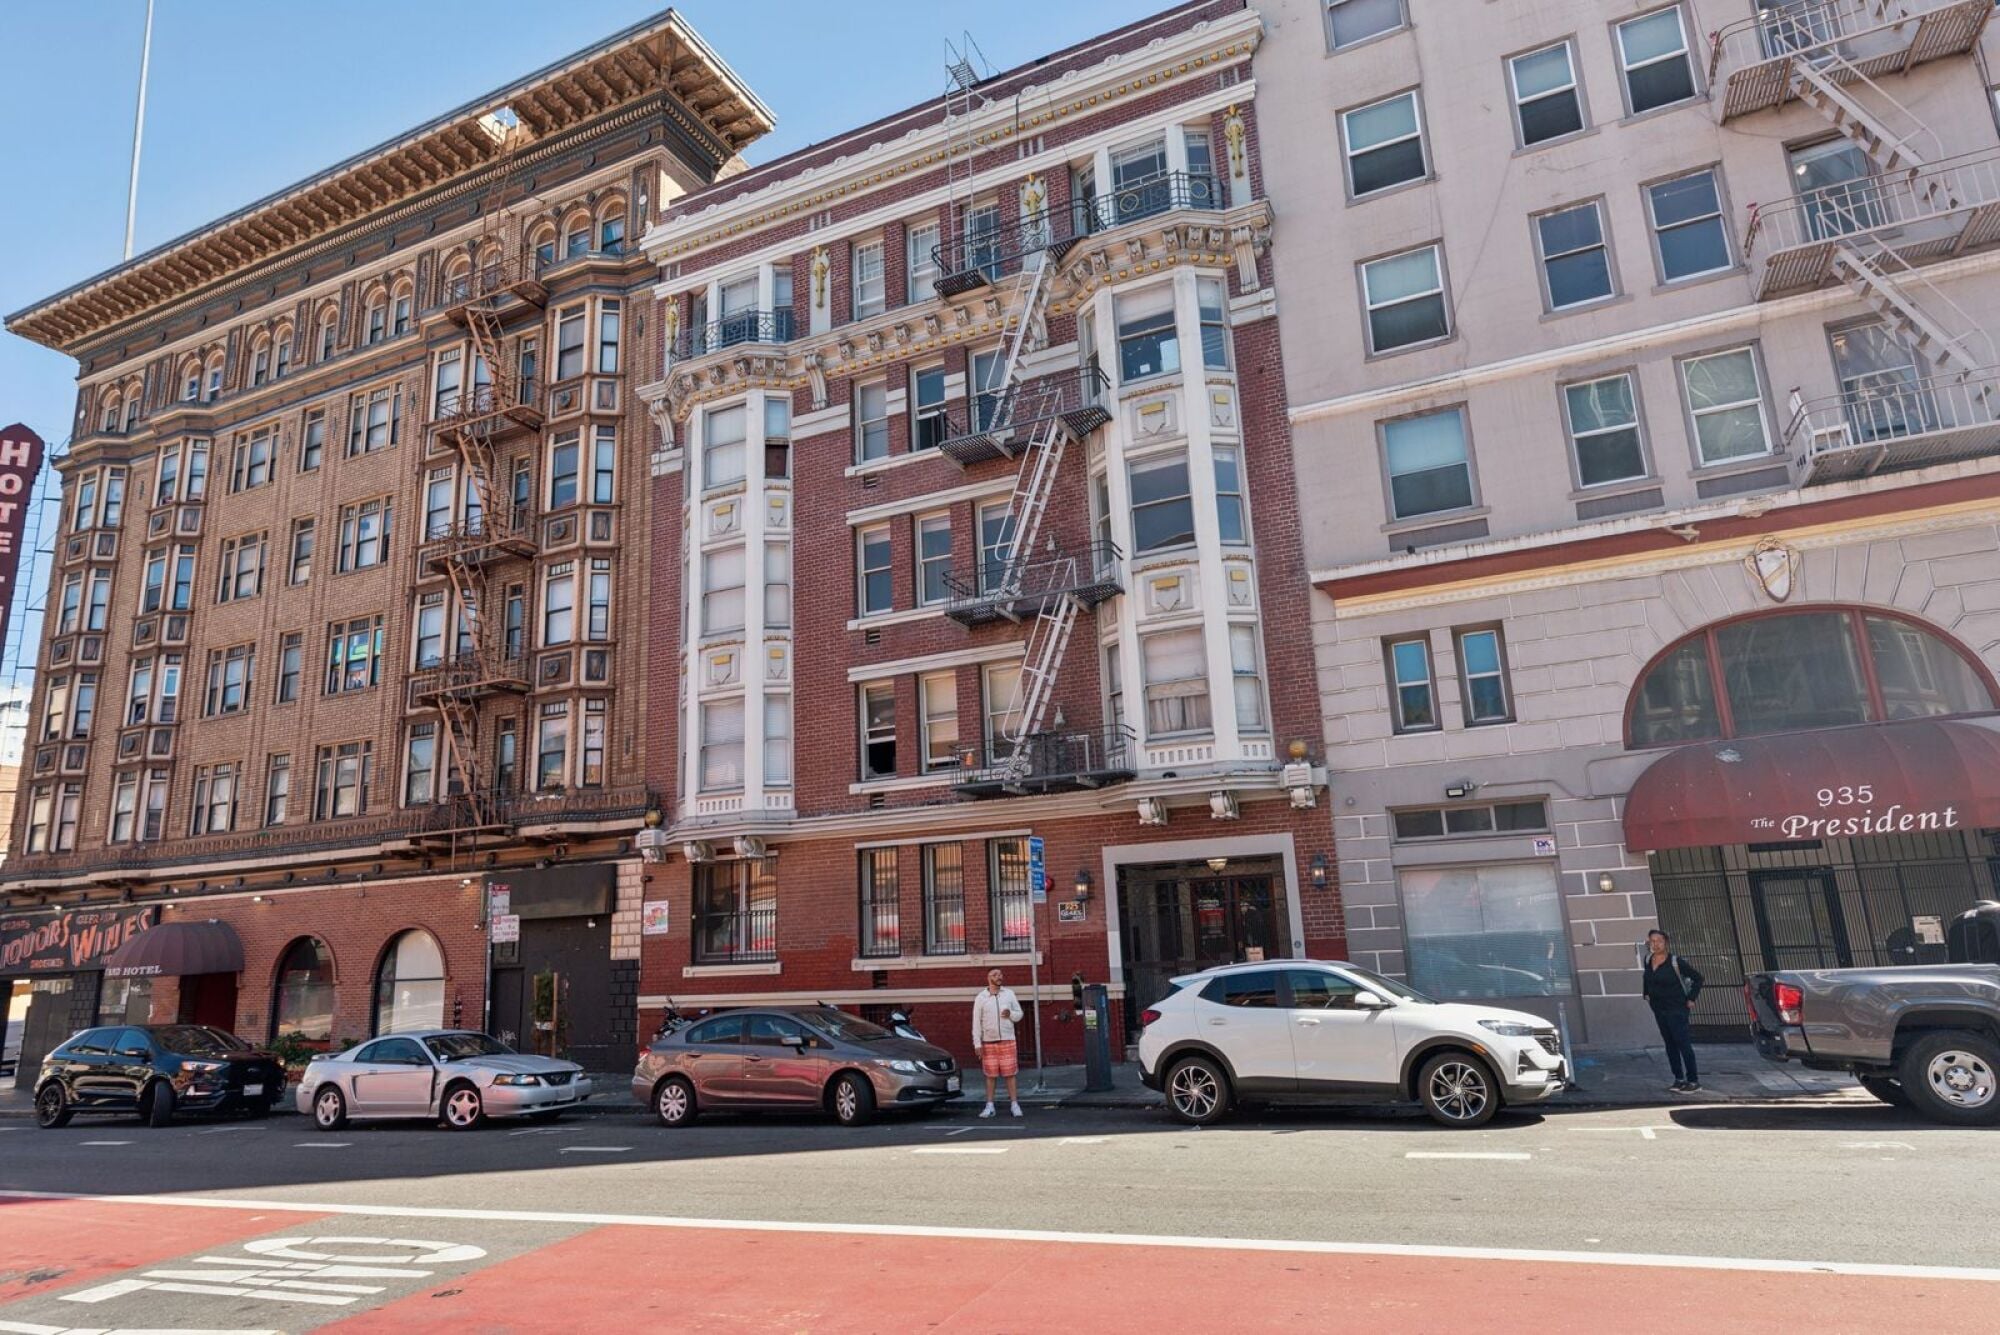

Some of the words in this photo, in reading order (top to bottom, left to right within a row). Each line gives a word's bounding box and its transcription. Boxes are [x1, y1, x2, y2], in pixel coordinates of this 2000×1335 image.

[0, 440, 30, 582] HOTE
[1817, 785, 1873, 807] 935
[1751, 817, 1775, 828] The
[1781, 805, 1959, 839] President
[0, 913, 72, 969] IQUORS
[122, 965, 163, 976] HOTEL
